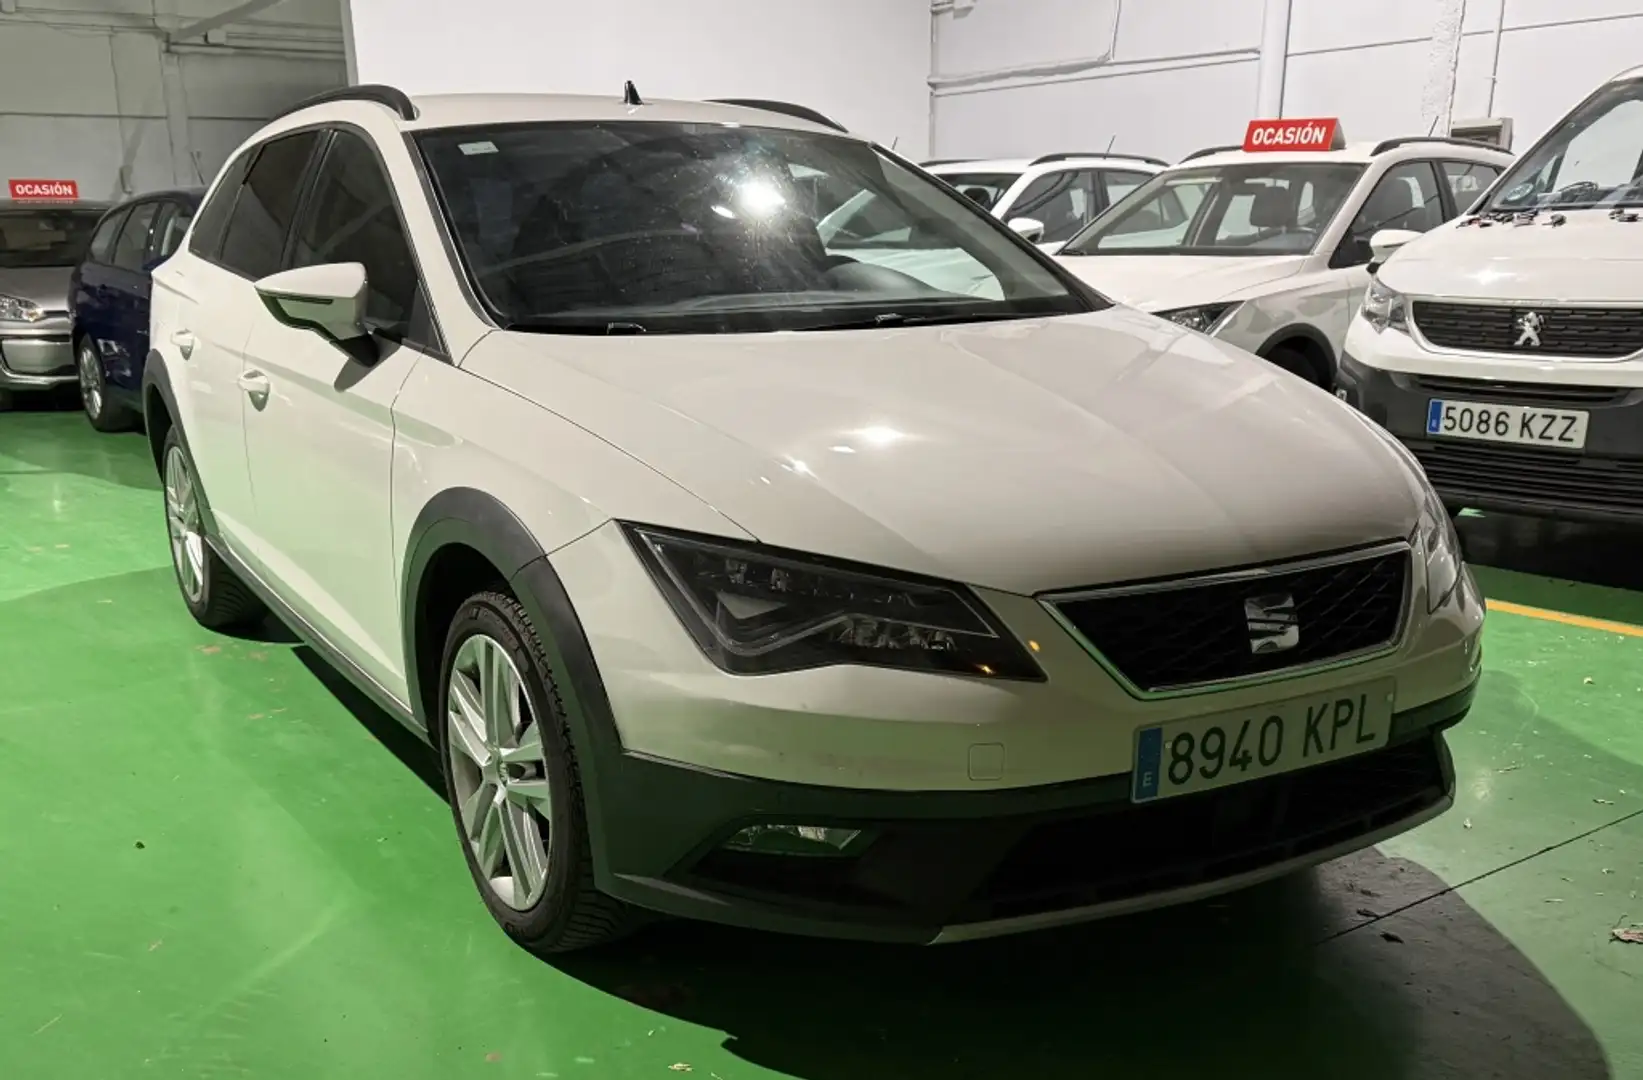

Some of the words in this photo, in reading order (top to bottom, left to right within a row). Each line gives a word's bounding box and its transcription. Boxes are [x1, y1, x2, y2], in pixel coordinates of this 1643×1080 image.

[1252, 122, 1327, 145] OCASIÓN
[15, 181, 73, 195] OCASIÓN
[1443, 406, 1510, 436] 5086
[1519, 412, 1577, 442] KZZ
[1168, 715, 1284, 785] 8940
[1302, 694, 1376, 758] KPL
[1142, 771, 1153, 787] E
